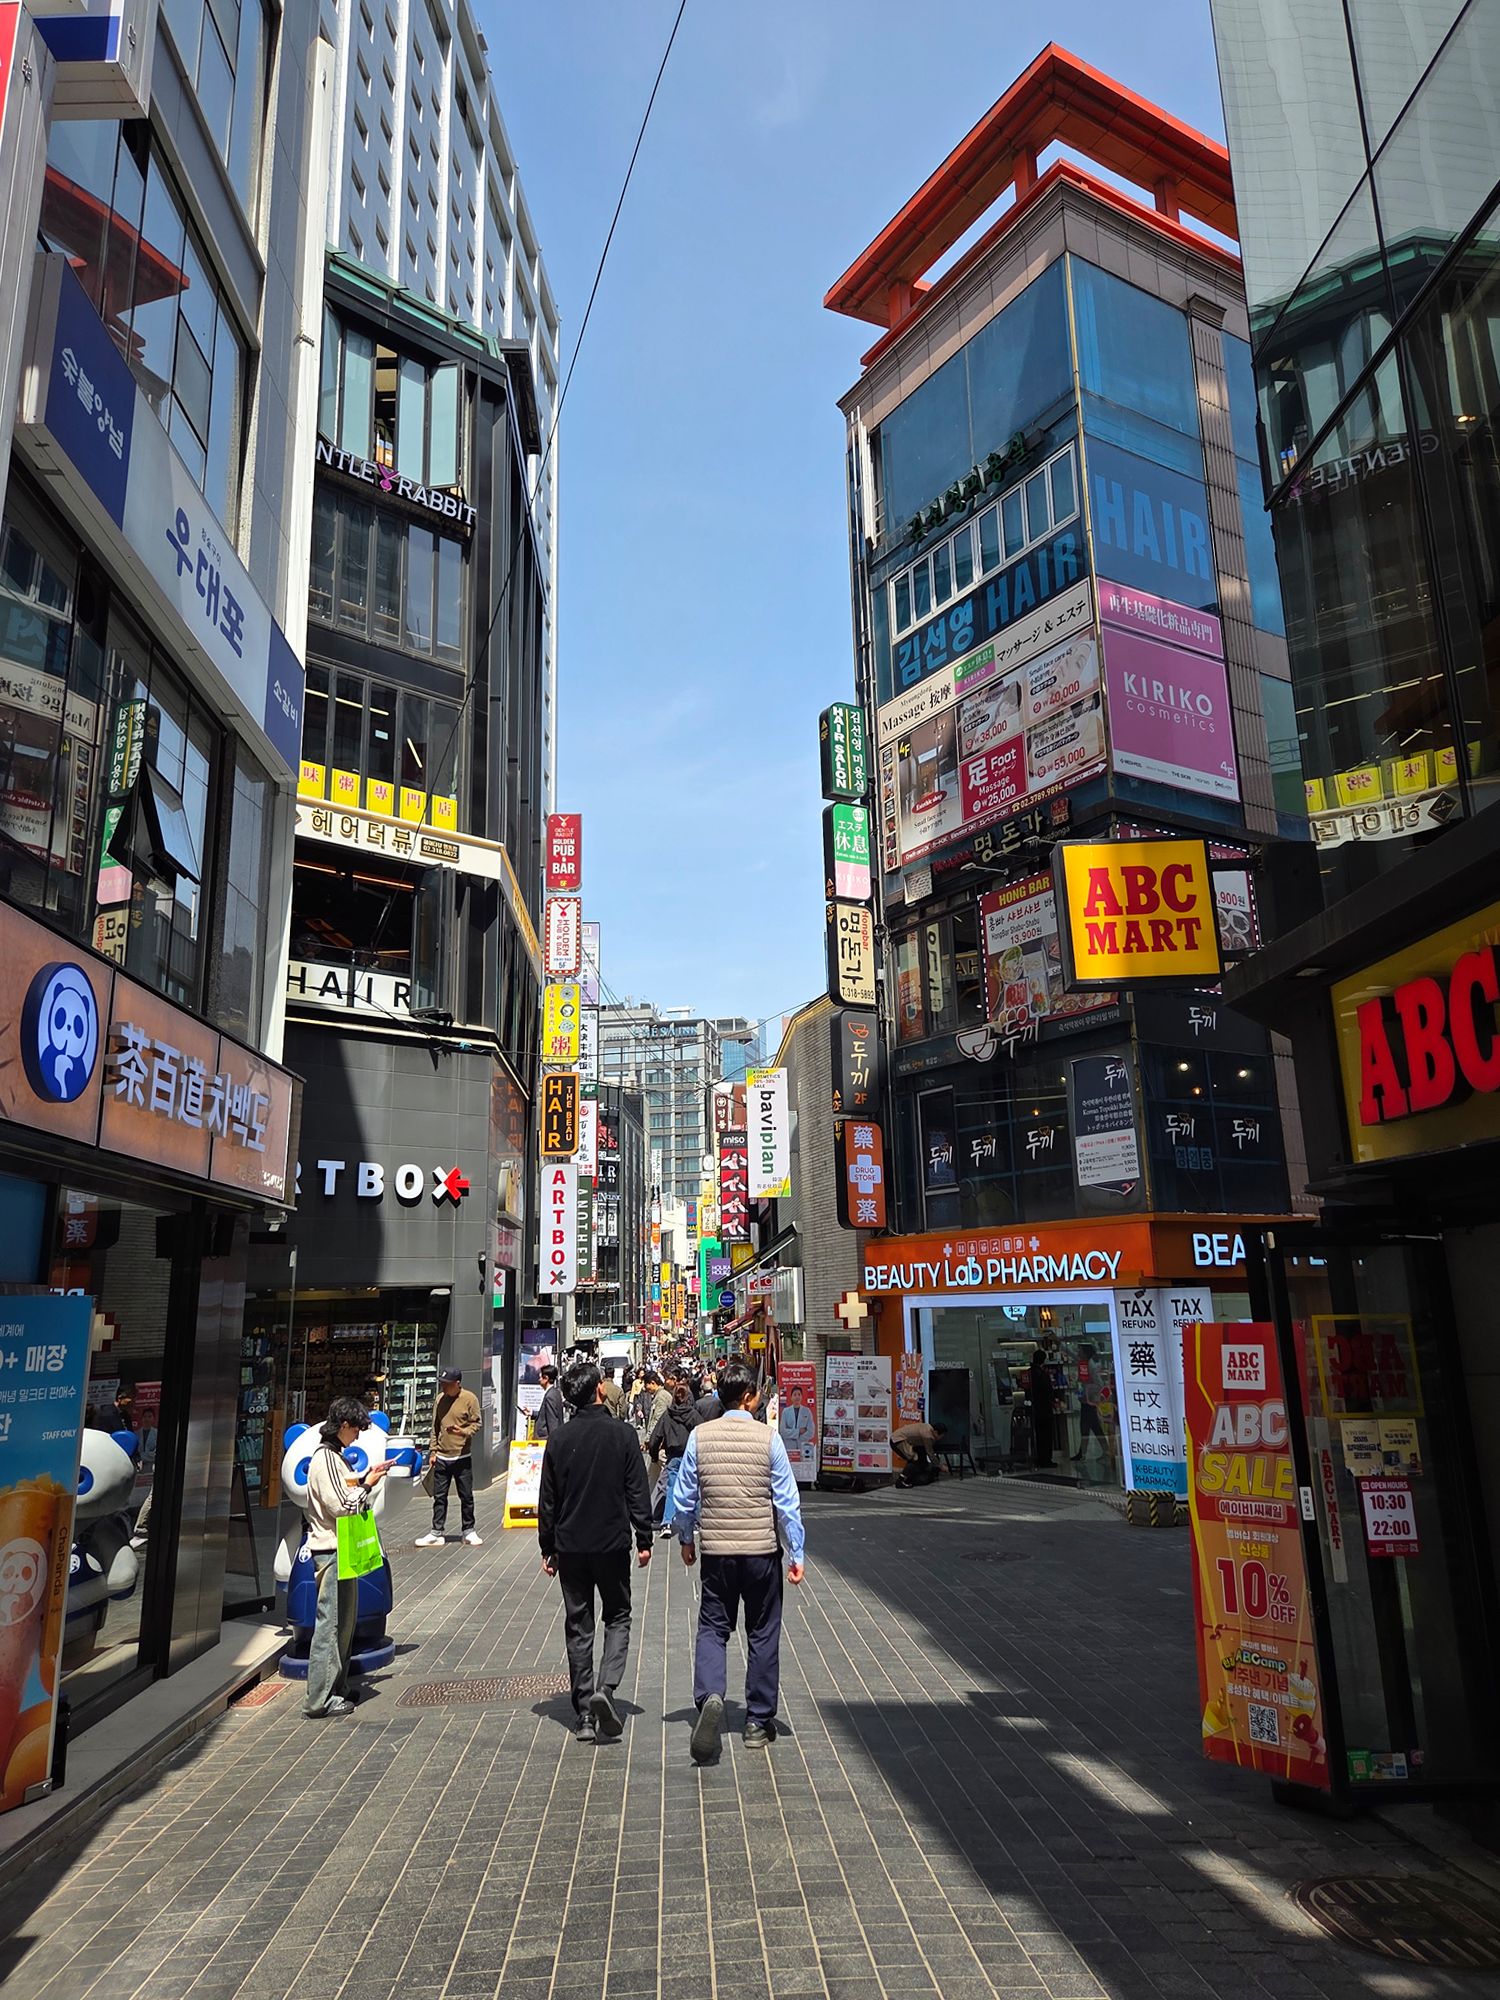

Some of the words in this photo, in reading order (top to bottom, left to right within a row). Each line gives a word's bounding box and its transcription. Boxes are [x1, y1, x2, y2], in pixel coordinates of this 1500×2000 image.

[395, 472, 477, 527] RABBIT
[1095, 472, 1212, 581] HAIR
[166, 506, 245, 659] 우대포
[899, 600, 975, 687] 김선영
[986, 532, 1079, 633] HAIR
[996, 626, 1042, 662] マッサージ
[1043, 620, 1054, 634] &
[1055, 601, 1087, 627] エステ
[273, 679, 299, 729] 소갈비
[1122, 670, 1214, 718] KIRIKO
[832, 705, 845, 741] HAIR
[849, 711, 862, 750] 김선영
[881, 699, 926, 736] Massage
[1126, 699, 1215, 734] cosmetics
[899, 742, 911, 757] 4F
[833, 743, 847, 789] SALON
[851, 754, 864, 793] 미용실
[968, 756, 989, 790] 足
[990, 747, 1017, 771] Foot
[1220, 760, 1234, 777] 4F
[978, 774, 1010, 797] Massage
[311, 808, 414, 855] 헤어더뷰
[836, 830, 868, 854] 休息
[837, 820, 864, 833] エステ
[974, 808, 1044, 864] 명돈가
[552, 845, 576, 857] PUB
[552, 862, 576, 874] BAR
[998, 886, 1027, 906] HONG
[1027, 876, 1051, 894] BAR
[1083, 863, 1198, 918] ABC
[1007, 902, 1041, 922] 샤브샤브
[562, 919, 570, 957] HOLDEM
[861, 909, 869, 952] Hongbar
[1009, 926, 1043, 945] 13,900원
[1085, 917, 1203, 956] MART
[840, 909, 863, 985] 명돈가
[286, 964, 411, 1009] HAIR
[1002, 1014, 1040, 1059] 두끼
[1188, 1006, 1217, 1036] 두끼
[1356, 943, 1500, 1126] ABC
[850, 1041, 871, 1089] 두끼
[116, 1022, 207, 1129] 茶百道
[207, 1072, 271, 1153] 차백도
[565, 1086, 574, 1109] THE
[854, 1092, 868, 1106] 2F
[547, 1079, 563, 1149] HAIR
[565, 1111, 574, 1142] BEAU
[1165, 1114, 1196, 1145] 두끼
[723, 1136, 745, 1144] miso
[760, 1091, 777, 1174] baviplan
[852, 1126, 874, 1150] 藥
[1026, 1130, 1055, 1160] 두끼
[1231, 1119, 1260, 1151] 두끼
[929, 1145, 953, 1174] 두끼
[970, 1138, 997, 1168] 두끼
[854, 1173, 876, 1182] STORE
[855, 1166, 876, 1175] DRUG
[549, 1169, 567, 1287] ARTBOX
[577, 1188, 589, 1266] ANOTHER
[864, 1261, 942, 1291] BEAUTY
[986, 1249, 1123, 1284] PHARMACY
[1120, 1300, 1155, 1317] TAX
[1170, 1298, 1203, 1316] TAX
[1121, 1319, 1157, 1330] REFUND
[24, 1344, 68, 1373] 매장
[1128, 1341, 1158, 1377] 藥
[1227, 1350, 1260, 1369] ABC
[1227, 1368, 1261, 1382] MART
[18, 1387, 48, 1402] 밀크티
[49, 1383, 78, 1400] 판매수
[1133, 1390, 1162, 1409] 中文
[41, 1429, 60, 1441] STAFF
[59, 1428, 78, 1440] ONLY
[1130, 1415, 1170, 1435] 日本語
[1209, 1404, 1287, 1448] ABC
[1131, 1441, 1176, 1457] ENGLISH
[1135, 1464, 1176, 1476] K-BEAUTY
[1135, 1475, 1178, 1489] PHARMACY
[1199, 1450, 1294, 1499] SALE
[1369, 1481, 1387, 1490] OPEN
[1386, 1481, 1409, 1490] HOURS
[1370, 1494, 1407, 1510] 10:30
[1372, 1520, 1411, 1536] 22:00
[53, 1525, 69, 1598] ChaPanda
[1216, 1556, 1289, 1620] 10%
[1271, 1603, 1297, 1624] OFF
[1234, 1647, 1287, 1672] ABCamp
